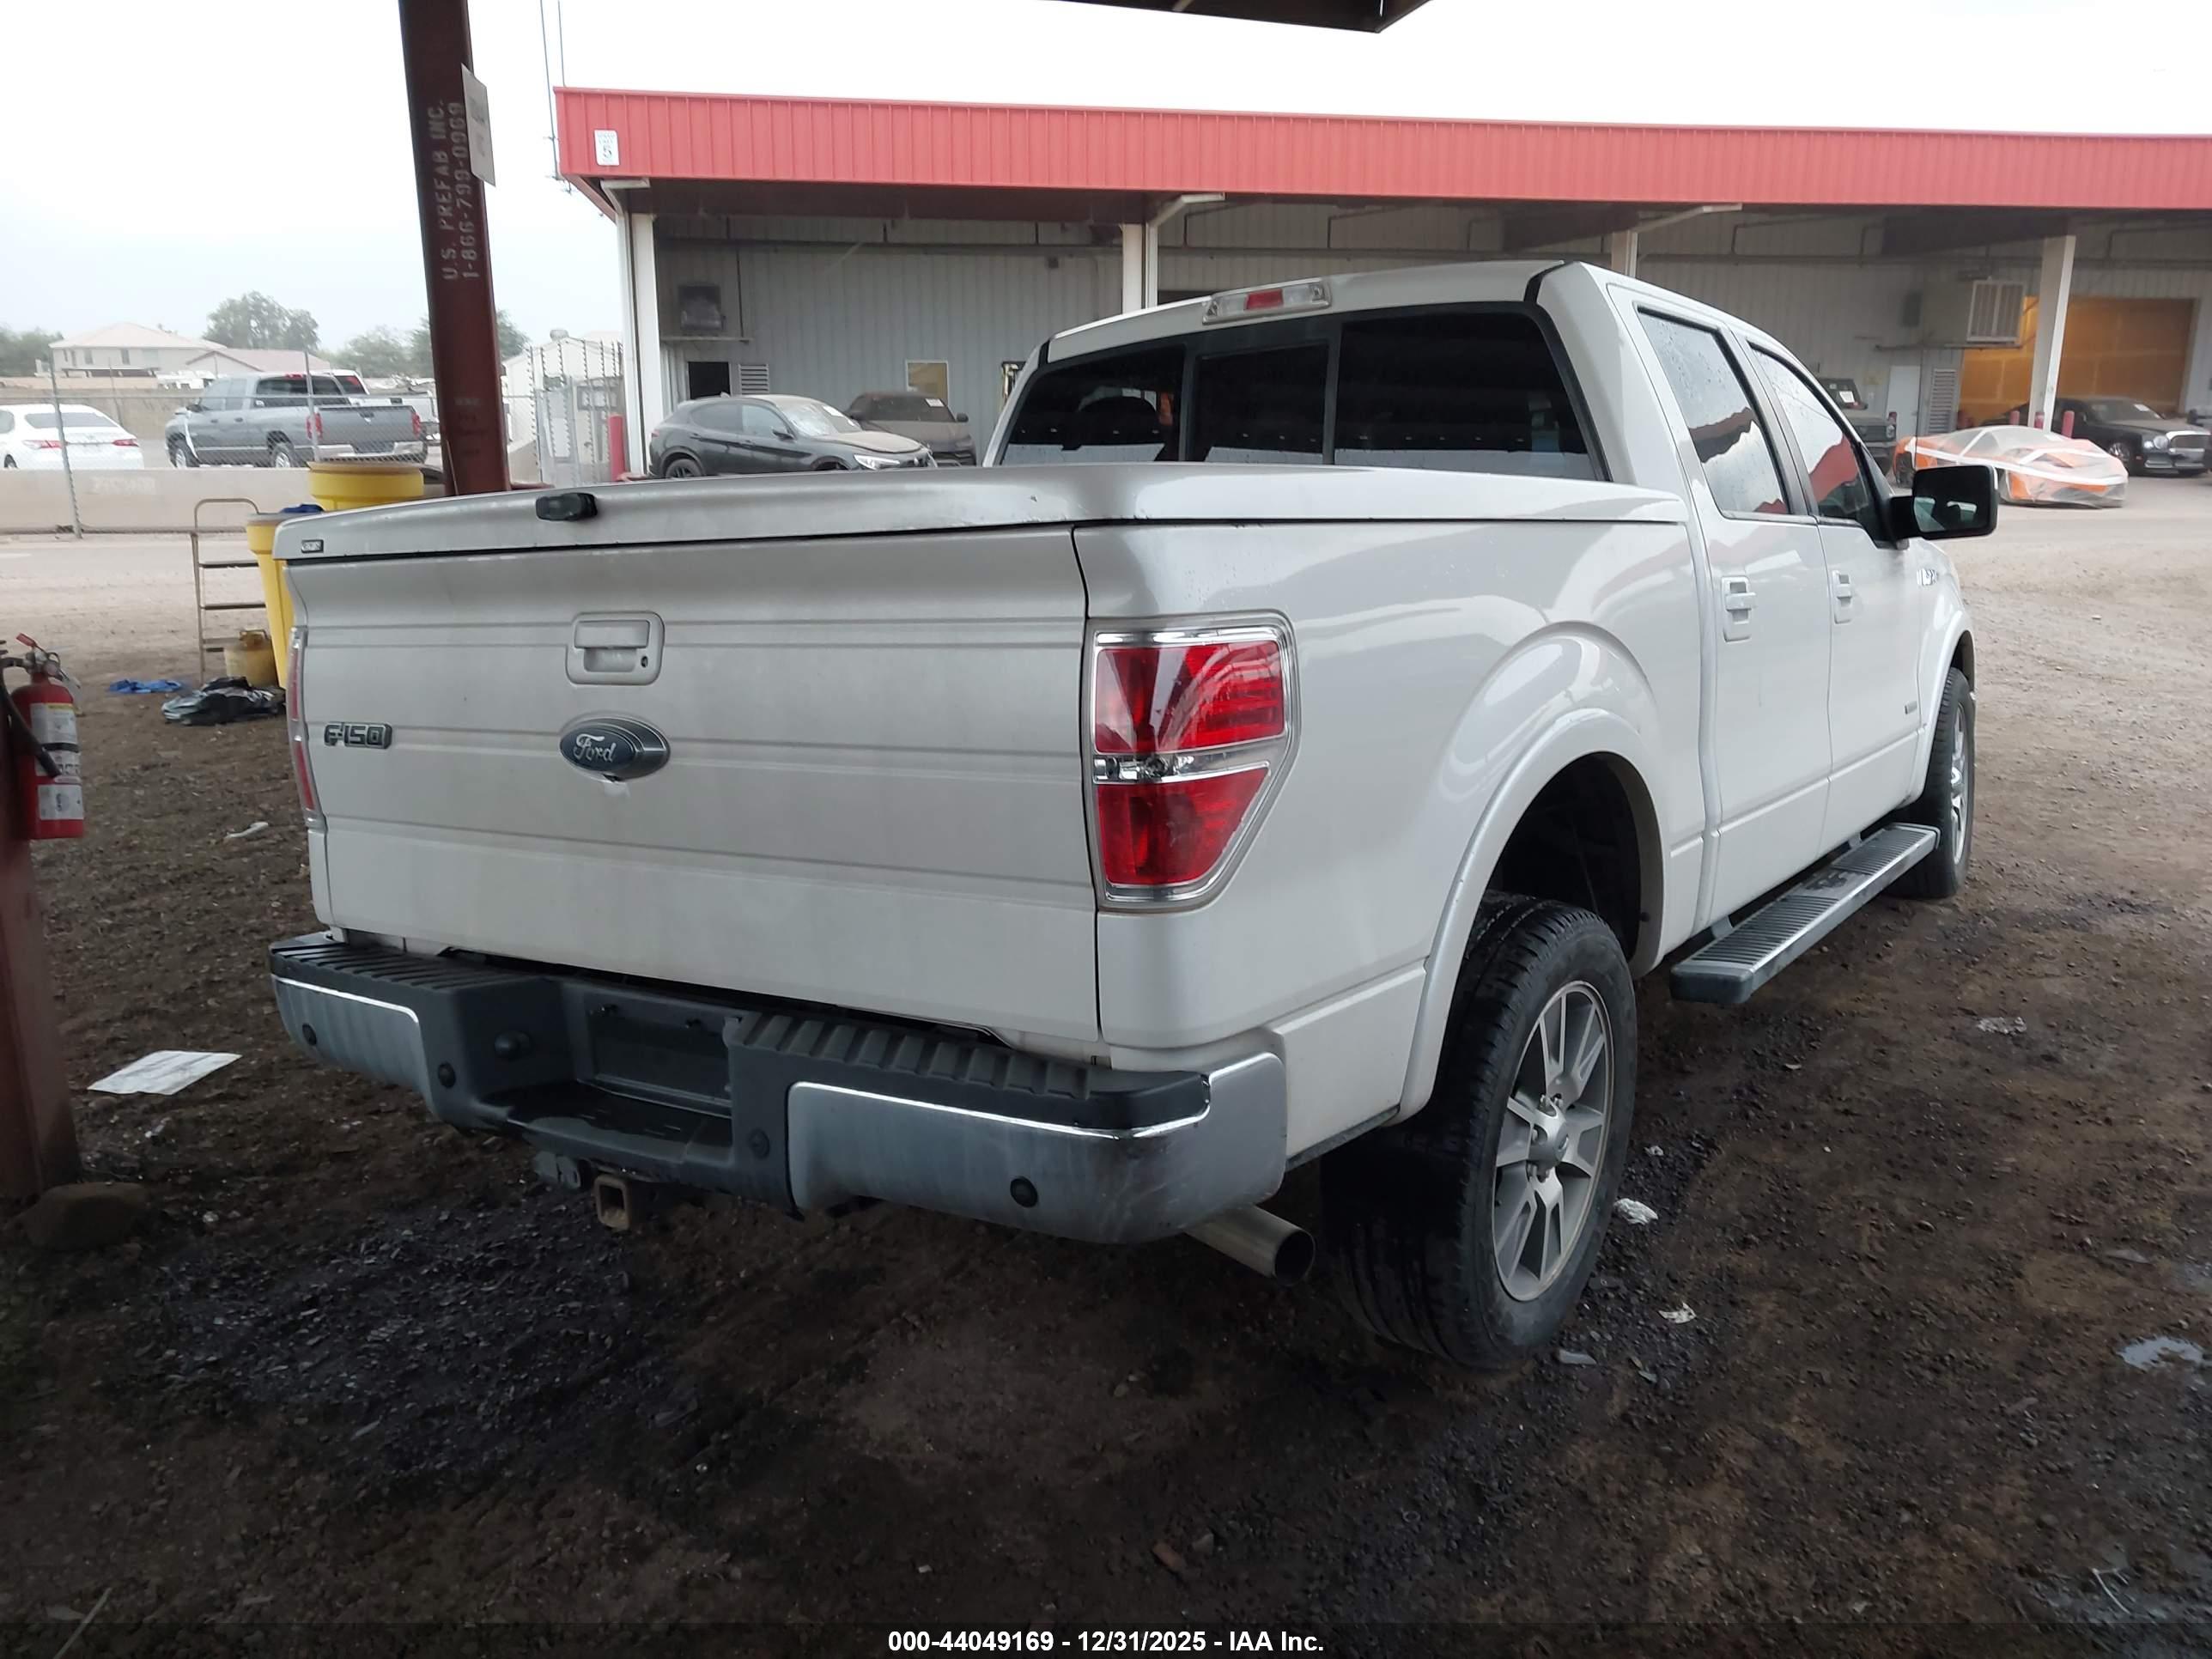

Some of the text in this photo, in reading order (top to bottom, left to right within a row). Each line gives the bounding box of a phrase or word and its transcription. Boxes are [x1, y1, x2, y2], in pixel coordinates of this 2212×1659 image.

[428, 100, 459, 280] U.S. PREFAB INC.
[573, 733, 617, 763] Ford
